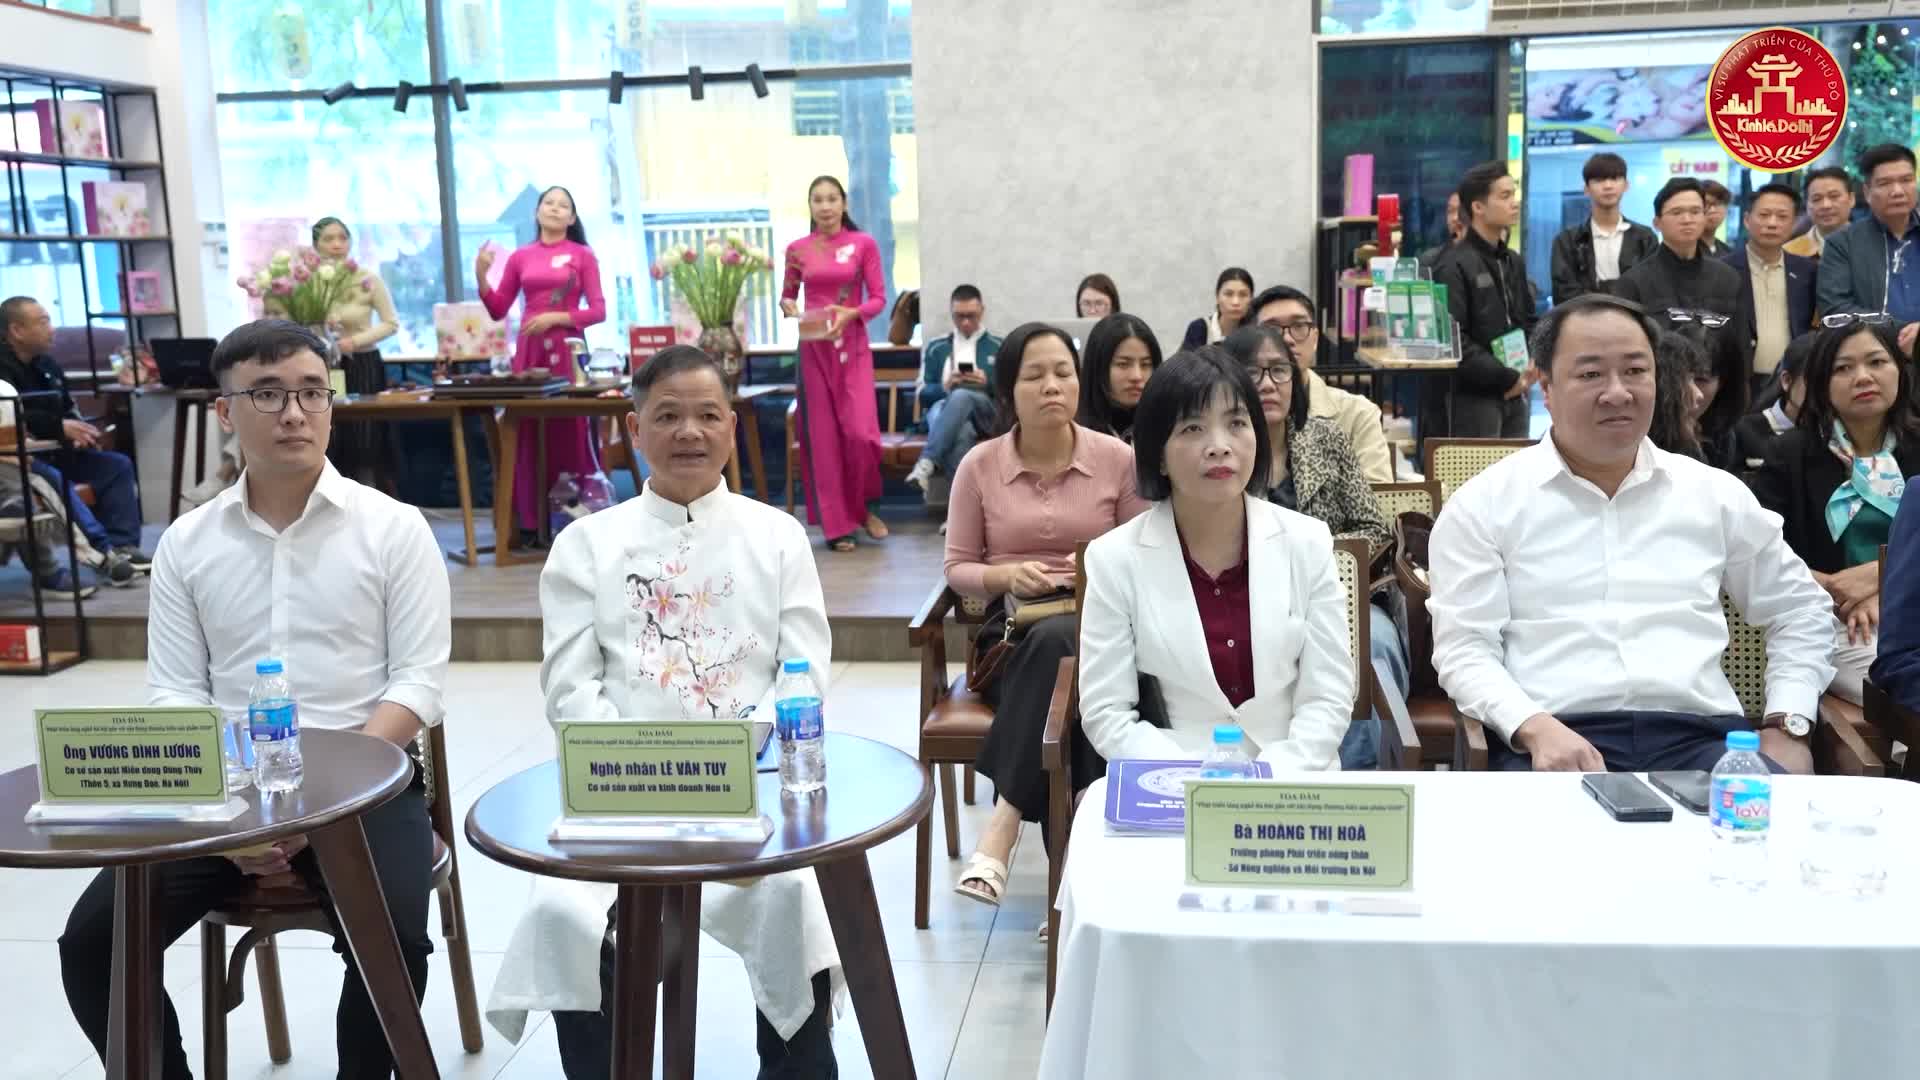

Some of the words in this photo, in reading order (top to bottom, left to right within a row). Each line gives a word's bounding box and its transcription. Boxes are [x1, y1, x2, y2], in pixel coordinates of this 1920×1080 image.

[64, 743, 87, 760] Ông
[89, 743, 129, 759] VƯƠNG
[163, 742, 201, 759] LƯƠNG
[590, 760, 622, 778] Nghệ
[625, 761, 657, 776] nhân
[660, 759, 673, 776] LÊ
[675, 759, 700, 776] VĂN
[1234, 823, 1253, 840] Bà
[1257, 821, 1305, 841] HOÀNG
[1309, 825, 1332, 844] THỊ
